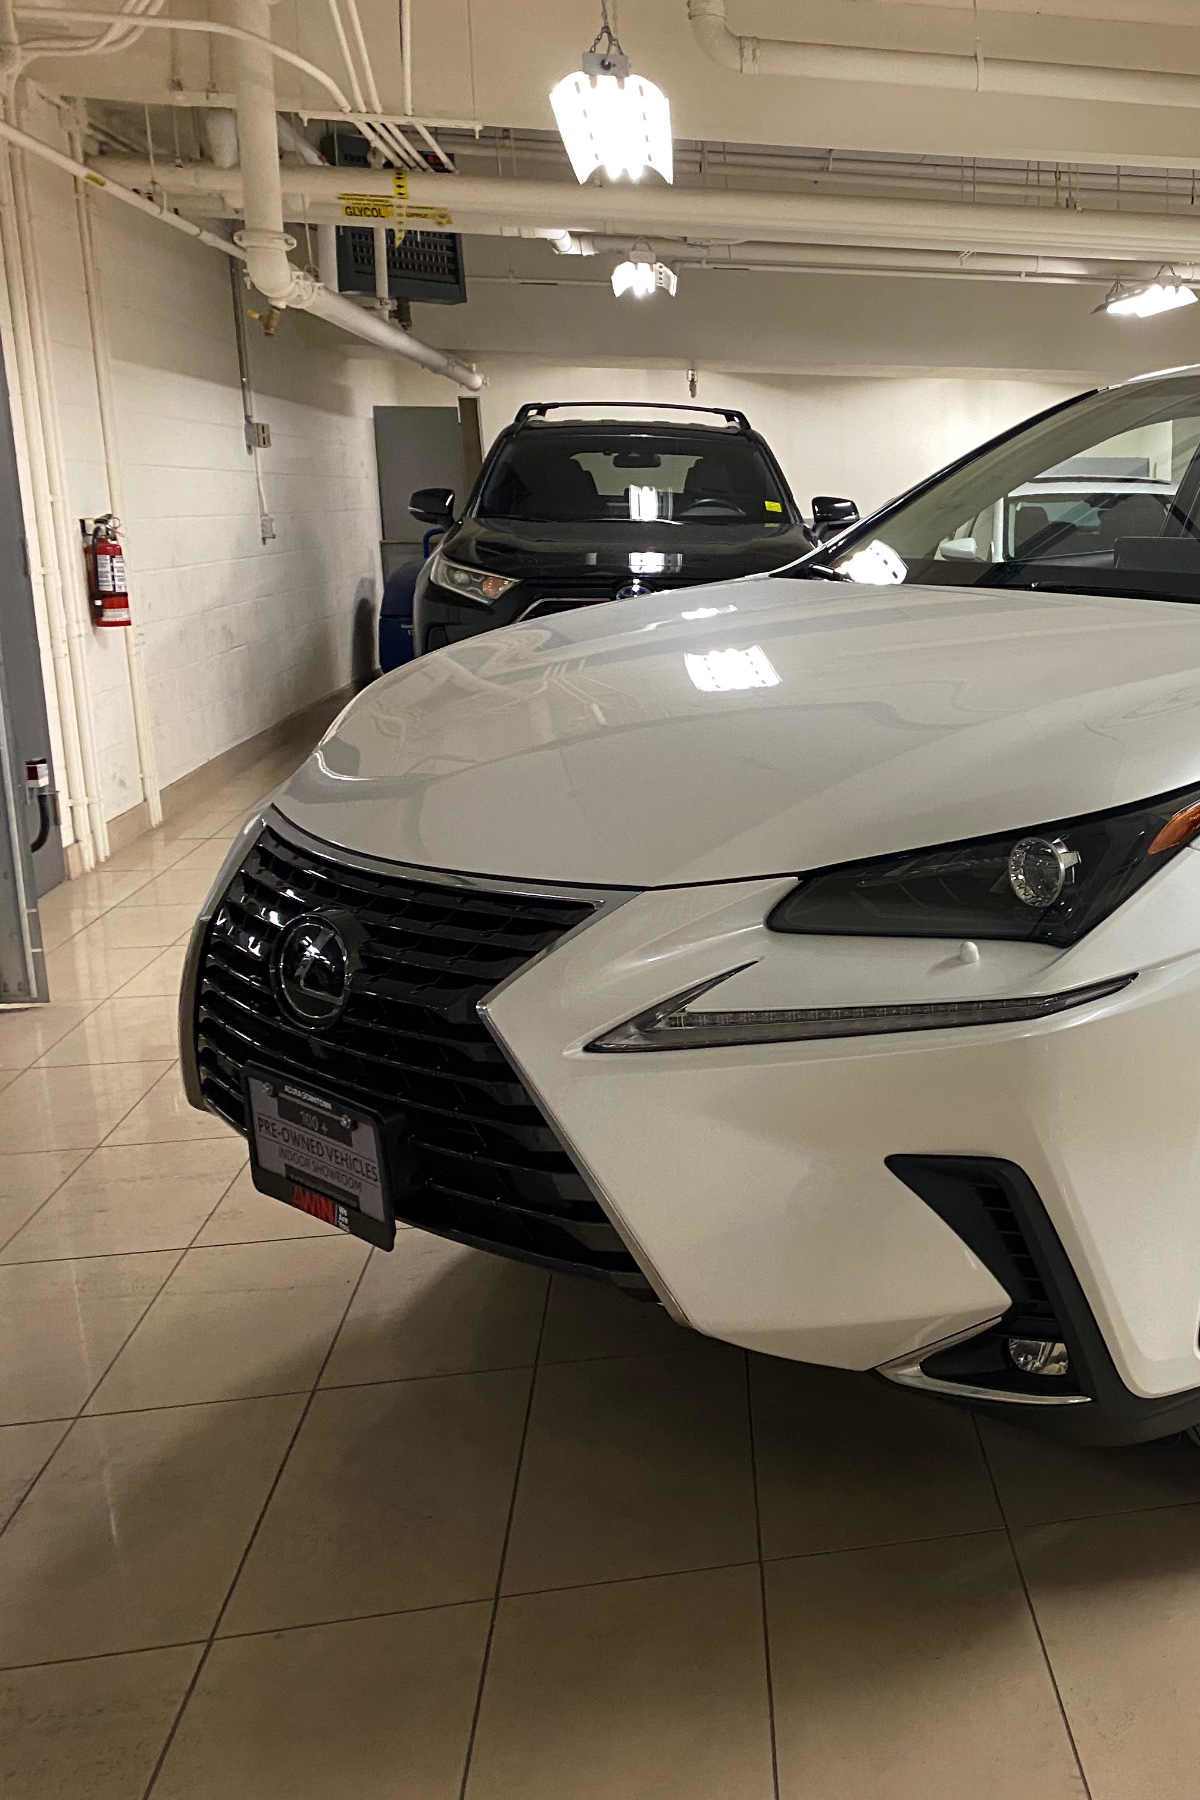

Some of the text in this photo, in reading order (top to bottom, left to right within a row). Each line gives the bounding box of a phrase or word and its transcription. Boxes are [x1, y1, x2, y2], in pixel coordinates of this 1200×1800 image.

[345, 206, 385, 218] GLYCOL
[258, 1117, 378, 1182] PRE-OWNED VEHICLES
